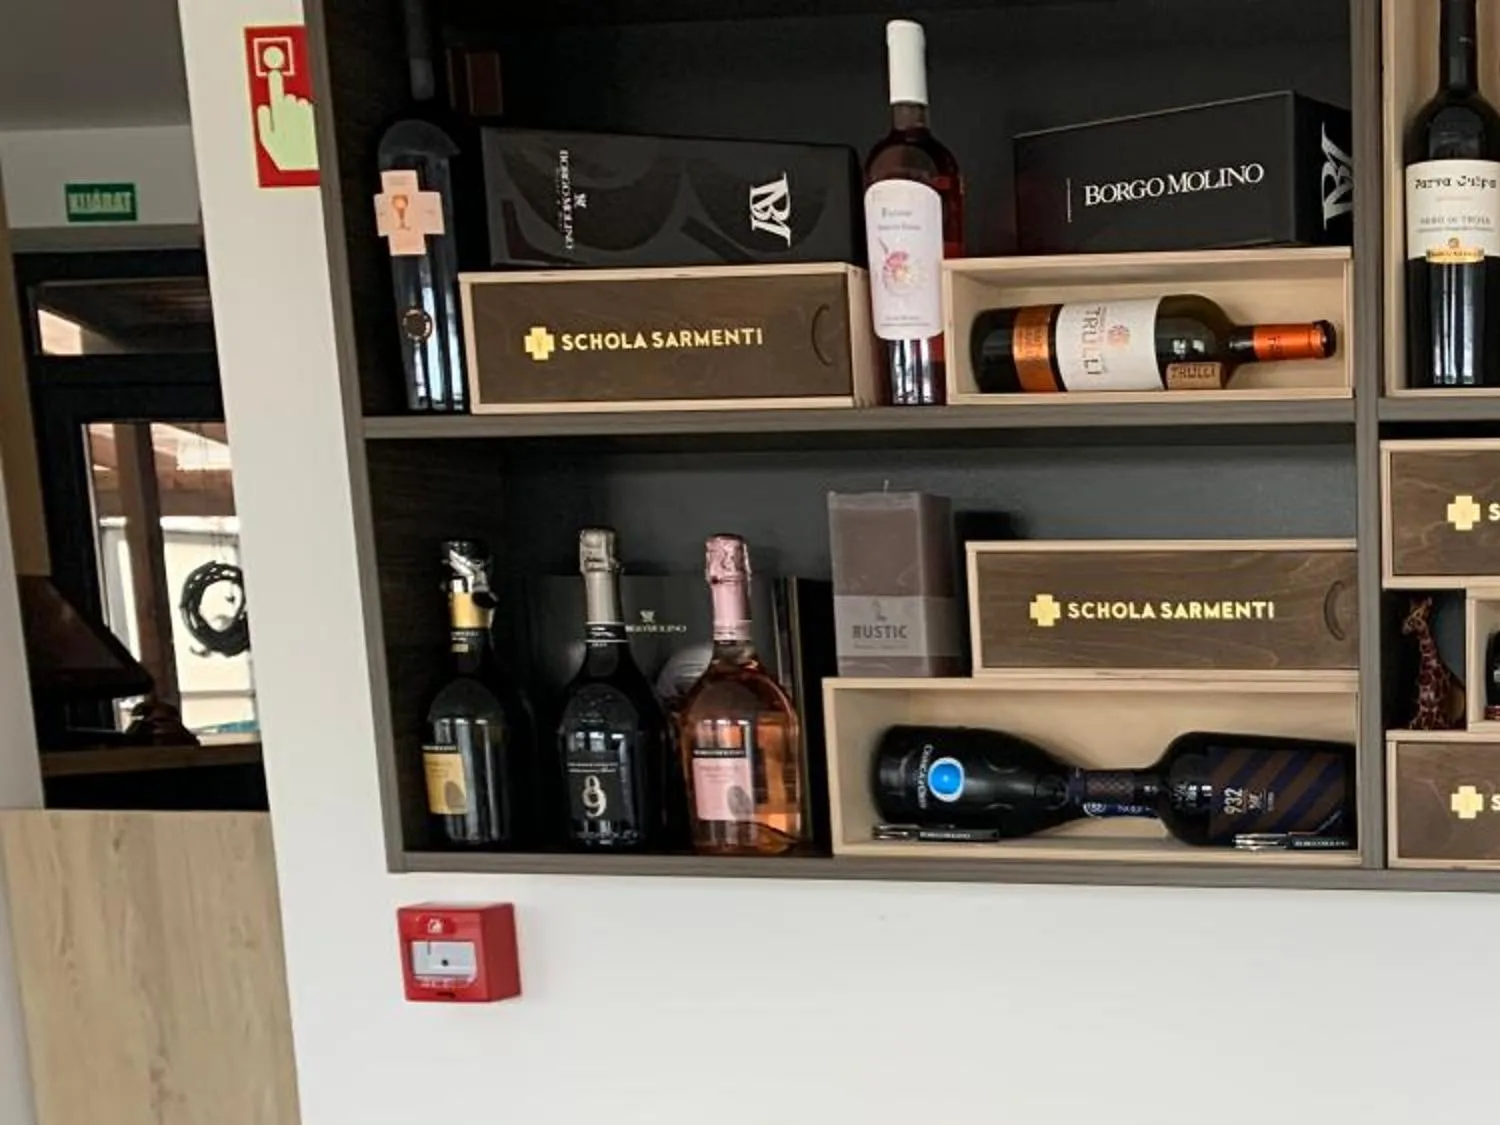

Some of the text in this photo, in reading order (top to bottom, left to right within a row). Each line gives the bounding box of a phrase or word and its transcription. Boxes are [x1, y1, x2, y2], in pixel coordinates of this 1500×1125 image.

[1084, 163, 1265, 207] BORGO MOLINO
[560, 327, 764, 352] SCHOLA SARMENTI
[1081, 306, 1103, 376] TRULLI
[1066, 600, 1276, 620] SCHOLA SARMENTI
[852, 625, 908, 639] RUSTIC
